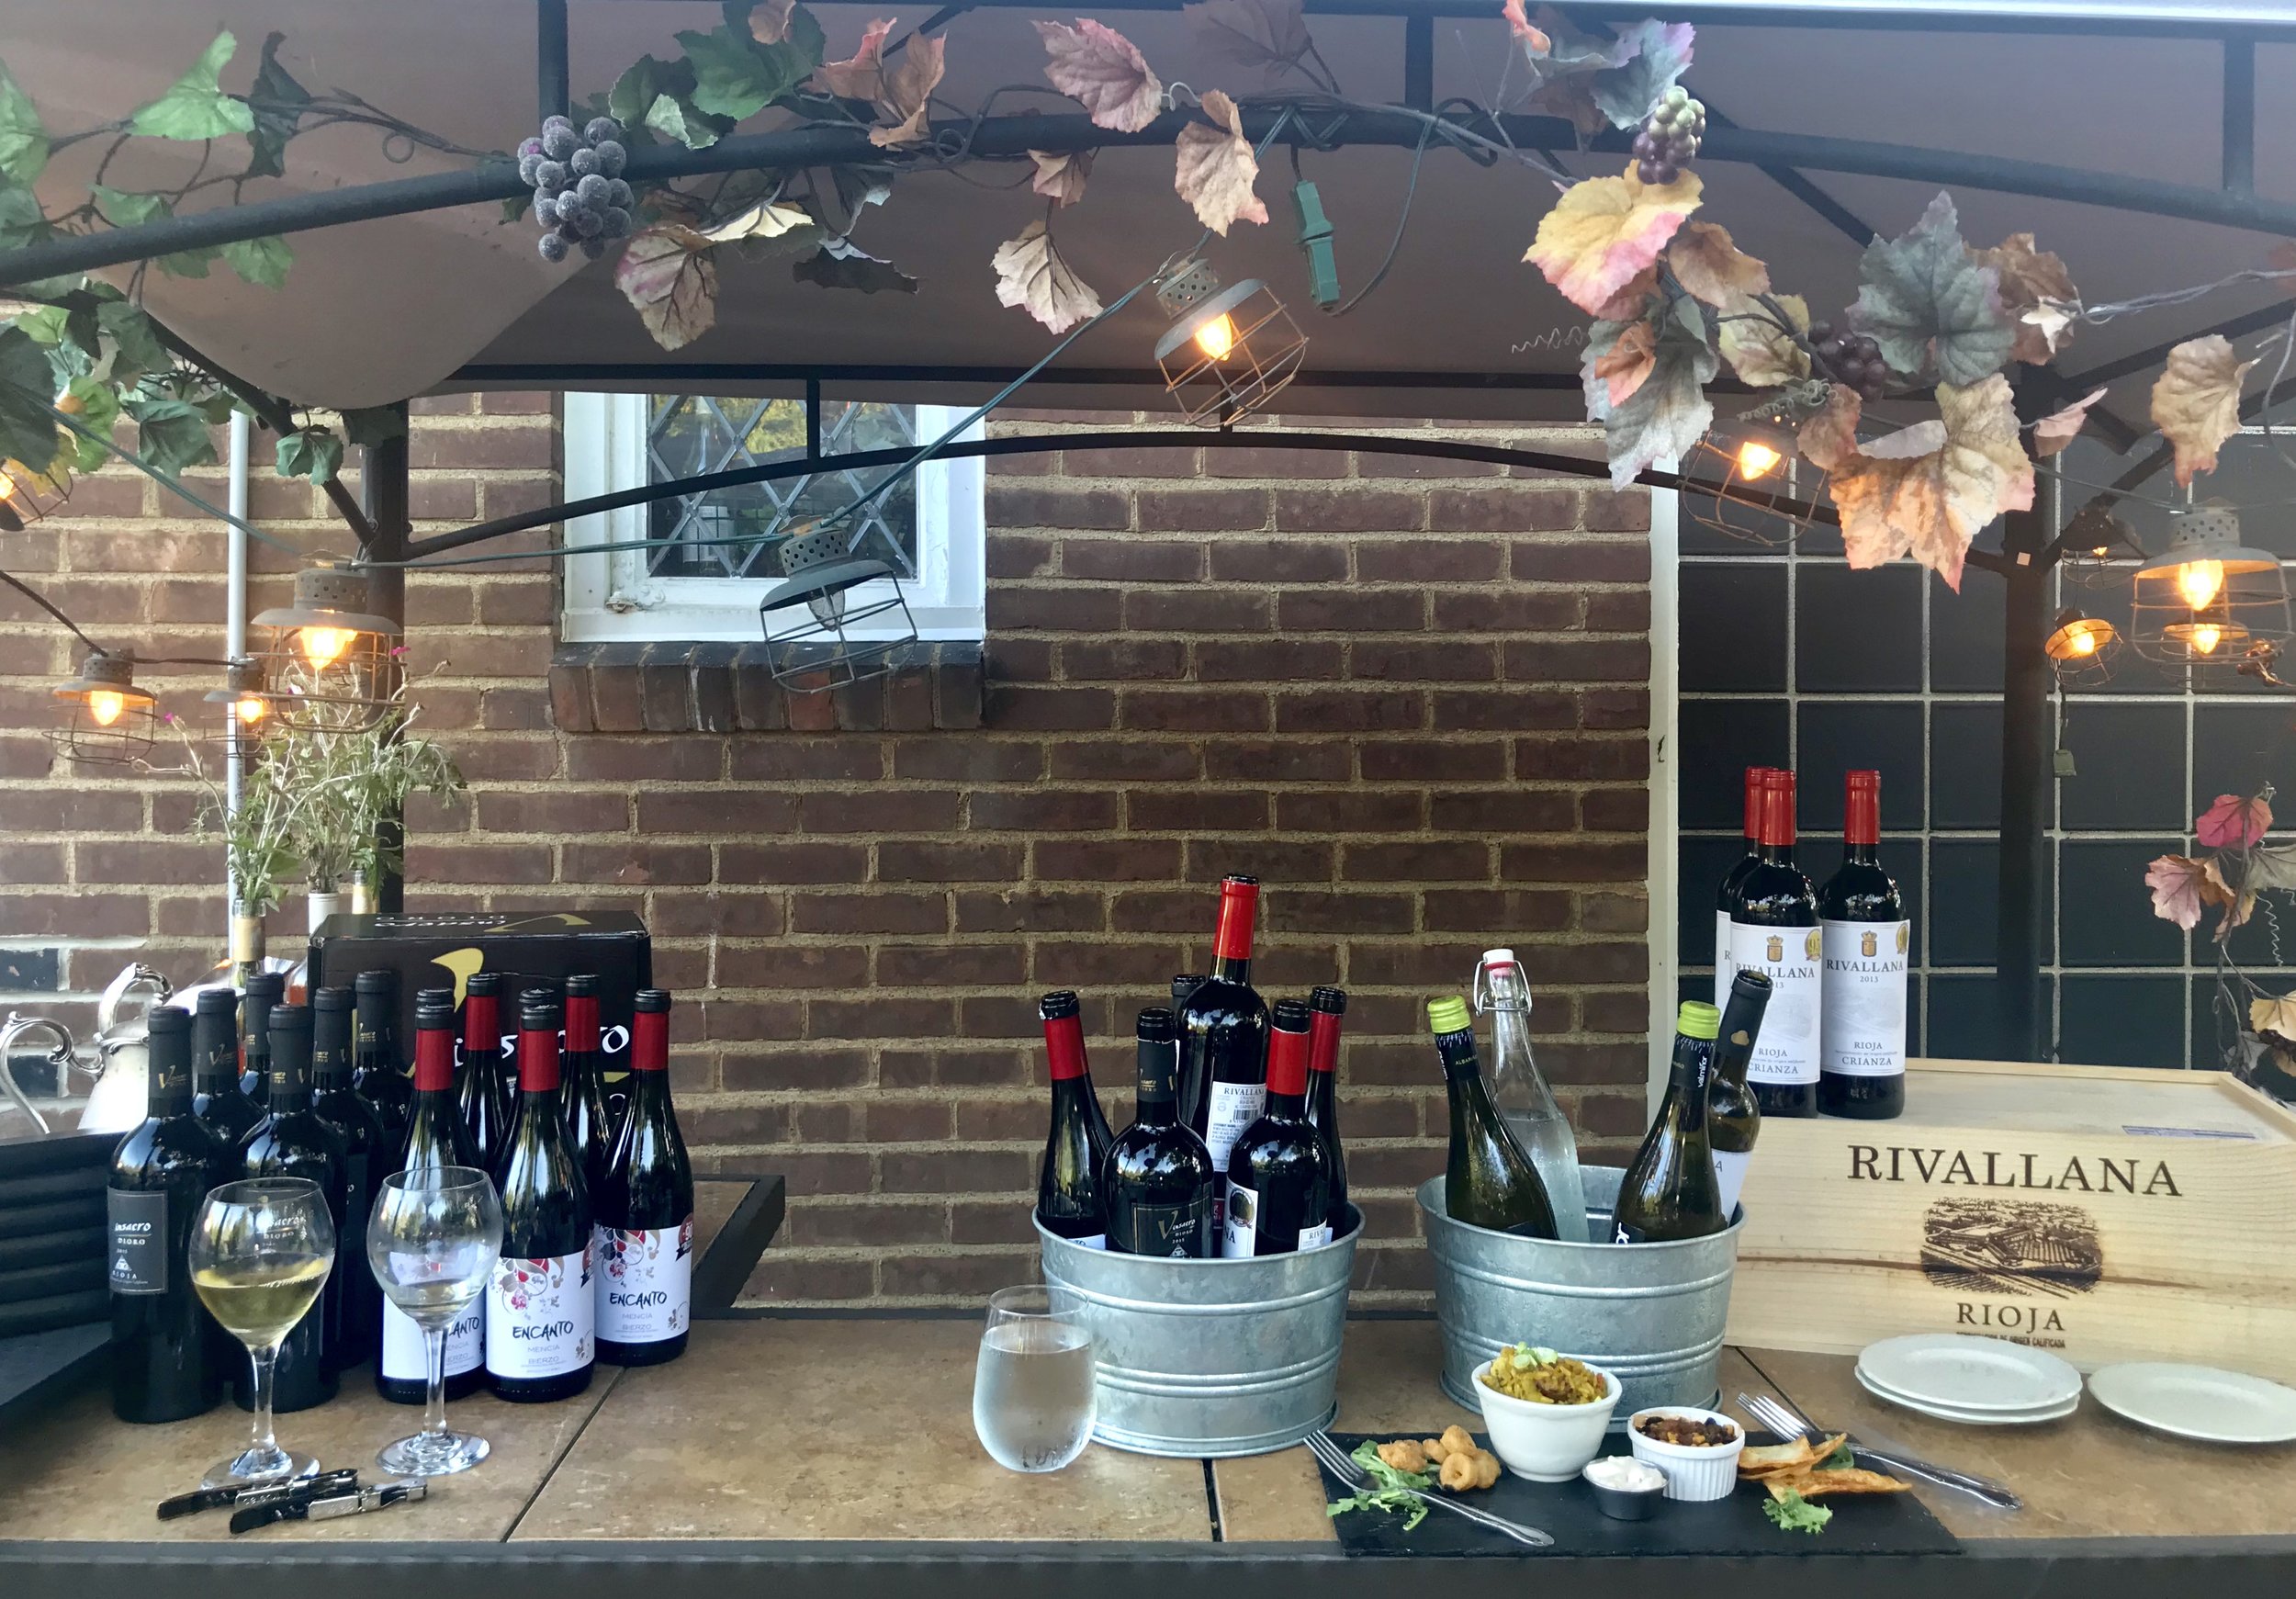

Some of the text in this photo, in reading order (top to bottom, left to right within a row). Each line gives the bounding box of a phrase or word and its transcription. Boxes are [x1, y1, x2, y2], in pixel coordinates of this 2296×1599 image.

[1826, 959, 1904, 973] RIVALLANA
[1758, 1048, 1788, 1058] RIOJA
[1854, 1042, 1883, 1052] RIOJA
[1841, 1056, 1893, 1065] CRIANZA
[1748, 1063, 1799, 1075] CRIANZA
[1224, 1087, 1265, 1096] RIVALLAN
[1847, 1144, 2183, 1197] RIVALLANA
[610, 1290, 668, 1310] ENCANTO
[1956, 1301, 2066, 1334] RIOJA
[449, 1316, 480, 1338] ANTO
[512, 1320, 574, 1342] ENCANTO
